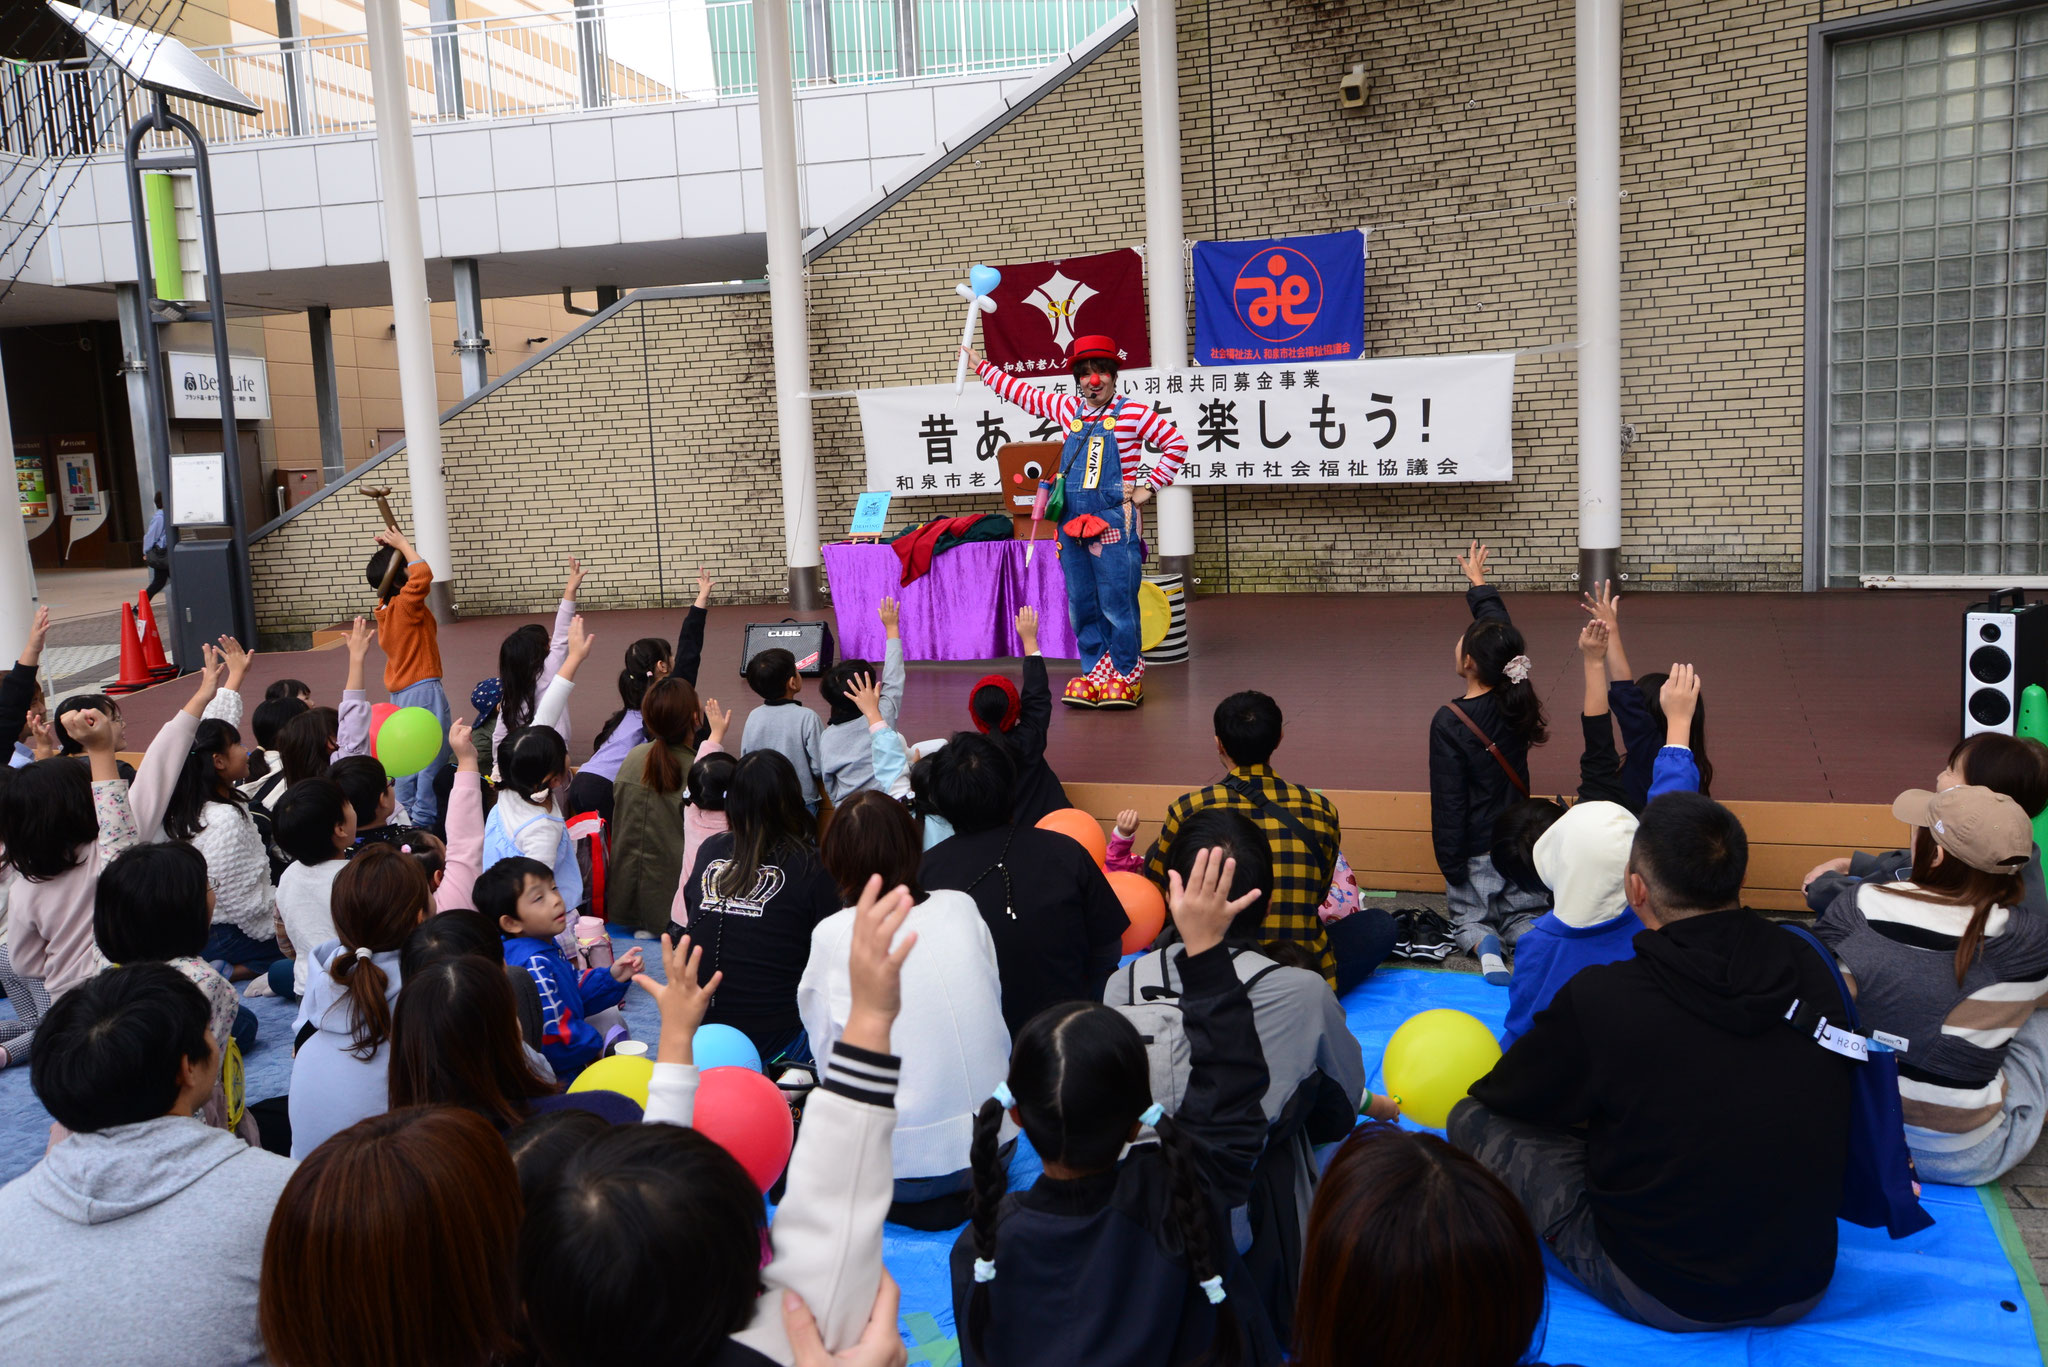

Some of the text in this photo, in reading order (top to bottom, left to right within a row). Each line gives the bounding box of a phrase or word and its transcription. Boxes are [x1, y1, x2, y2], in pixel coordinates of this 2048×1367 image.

[1047, 299, 1076, 319] SC
[1211, 342, 1351, 360] 社会福祉法人 和泉市社会福祉協議会
[1089, 441, 1102, 485] アミティー
[1181, 458, 1459, 479] 和泉市社会福祉協議会
